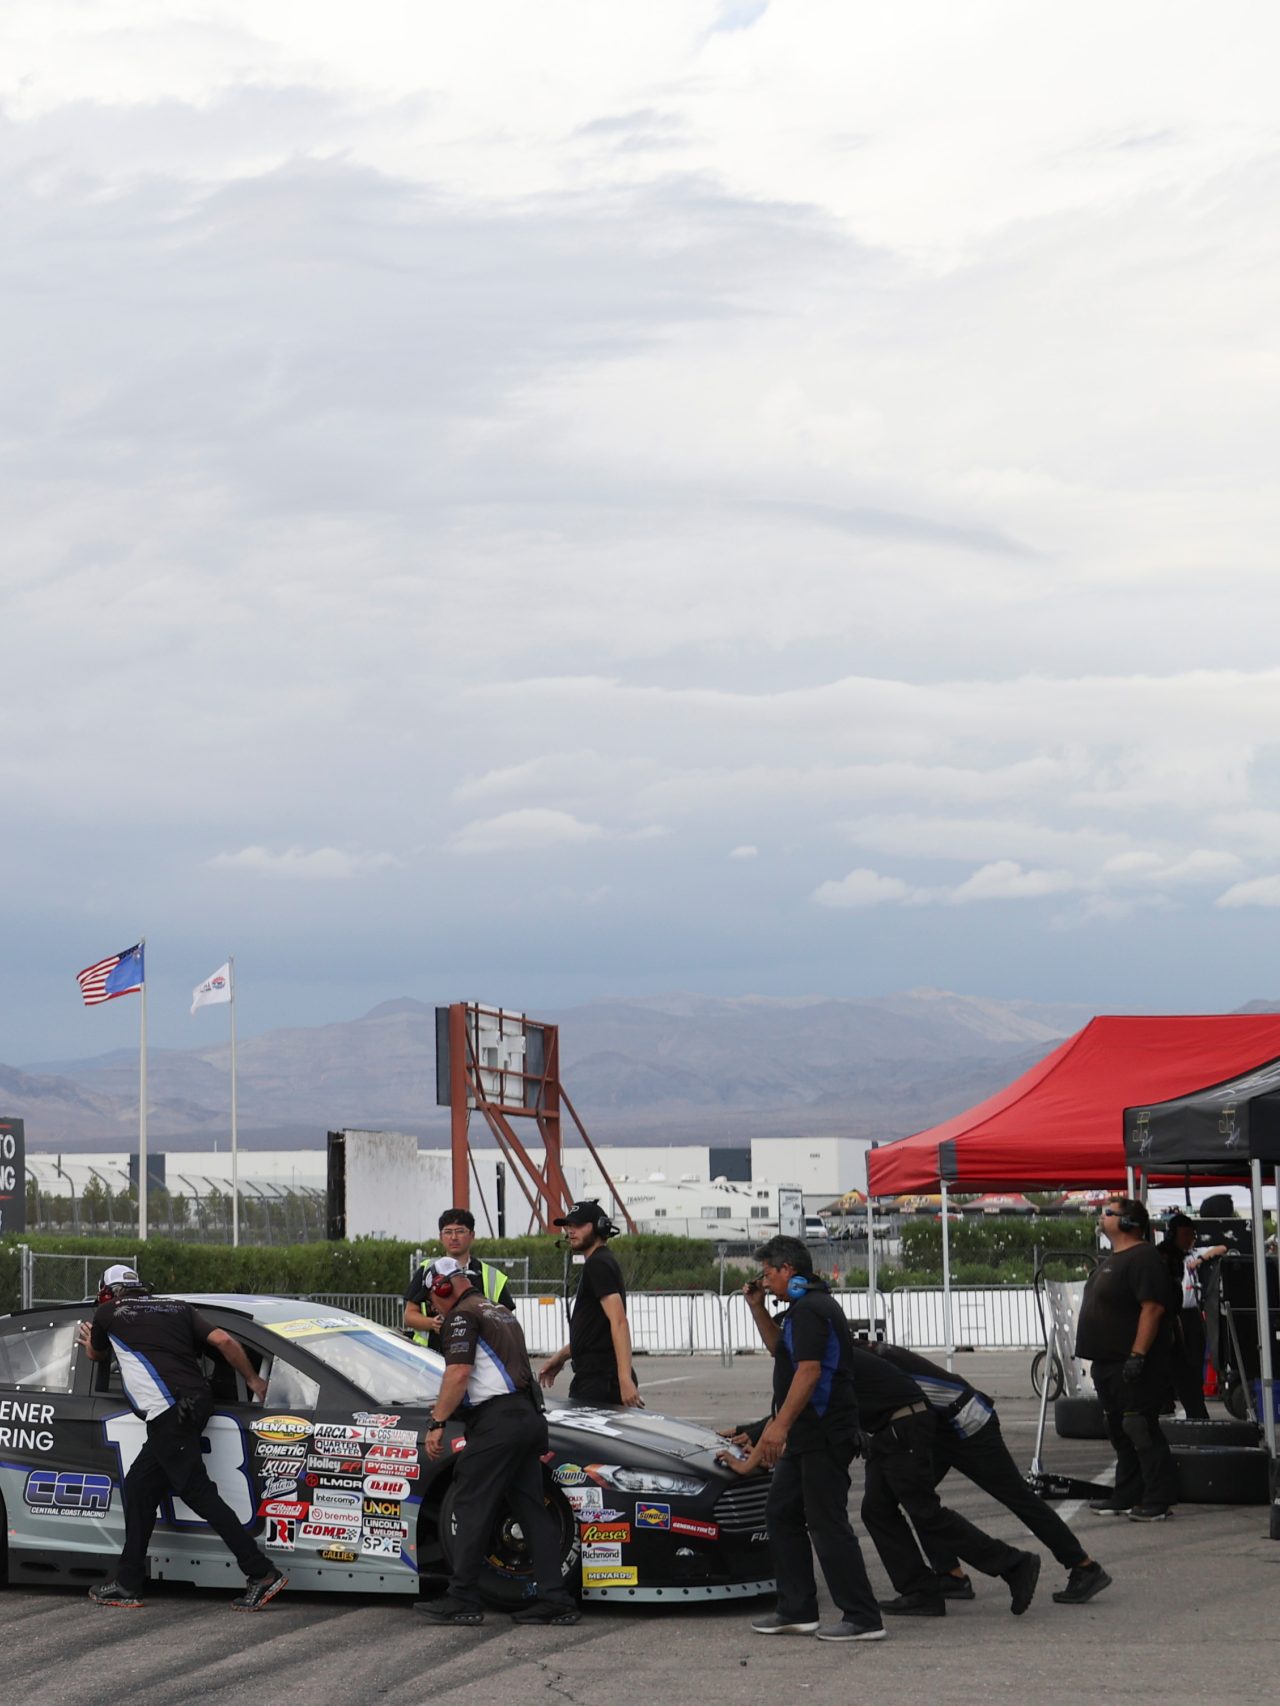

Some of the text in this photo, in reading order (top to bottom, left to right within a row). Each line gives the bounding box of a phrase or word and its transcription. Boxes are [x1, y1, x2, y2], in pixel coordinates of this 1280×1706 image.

[249, 1421, 315, 1435] MENARDS
[315, 1425, 347, 1439] ARCA
[315, 1440, 357, 1449] QUARTER
[323, 1448, 360, 1456] MASTER
[368, 1446, 418, 1459] ARP
[264, 1460, 301, 1474] KLOTZ
[308, 1455, 341, 1472] Holley
[367, 1462, 417, 1473] PYROTECT
[552, 1469, 587, 1485] Bounty
[25, 1470, 112, 1509] CCR
[320, 1478, 362, 1489] ILMOR
[316, 1493, 356, 1506] Intercomp
[31, 1506, 105, 1518] CENTRAL COAST RACING
[363, 1501, 400, 1516] UNOH
[324, 1511, 359, 1522] brembo
[638, 1511, 669, 1521] SUNOCO
[303, 1524, 347, 1537] COMP
[365, 1519, 400, 1530] LINCOLN
[672, 1522, 697, 1532] GENERAL
[373, 1528, 404, 1538] WELDERS
[583, 1526, 628, 1541] Reese's
[322, 1550, 355, 1560] CALLIES
[582, 1548, 620, 1560] Richmond
[587, 1572, 633, 1580] MENARDS
